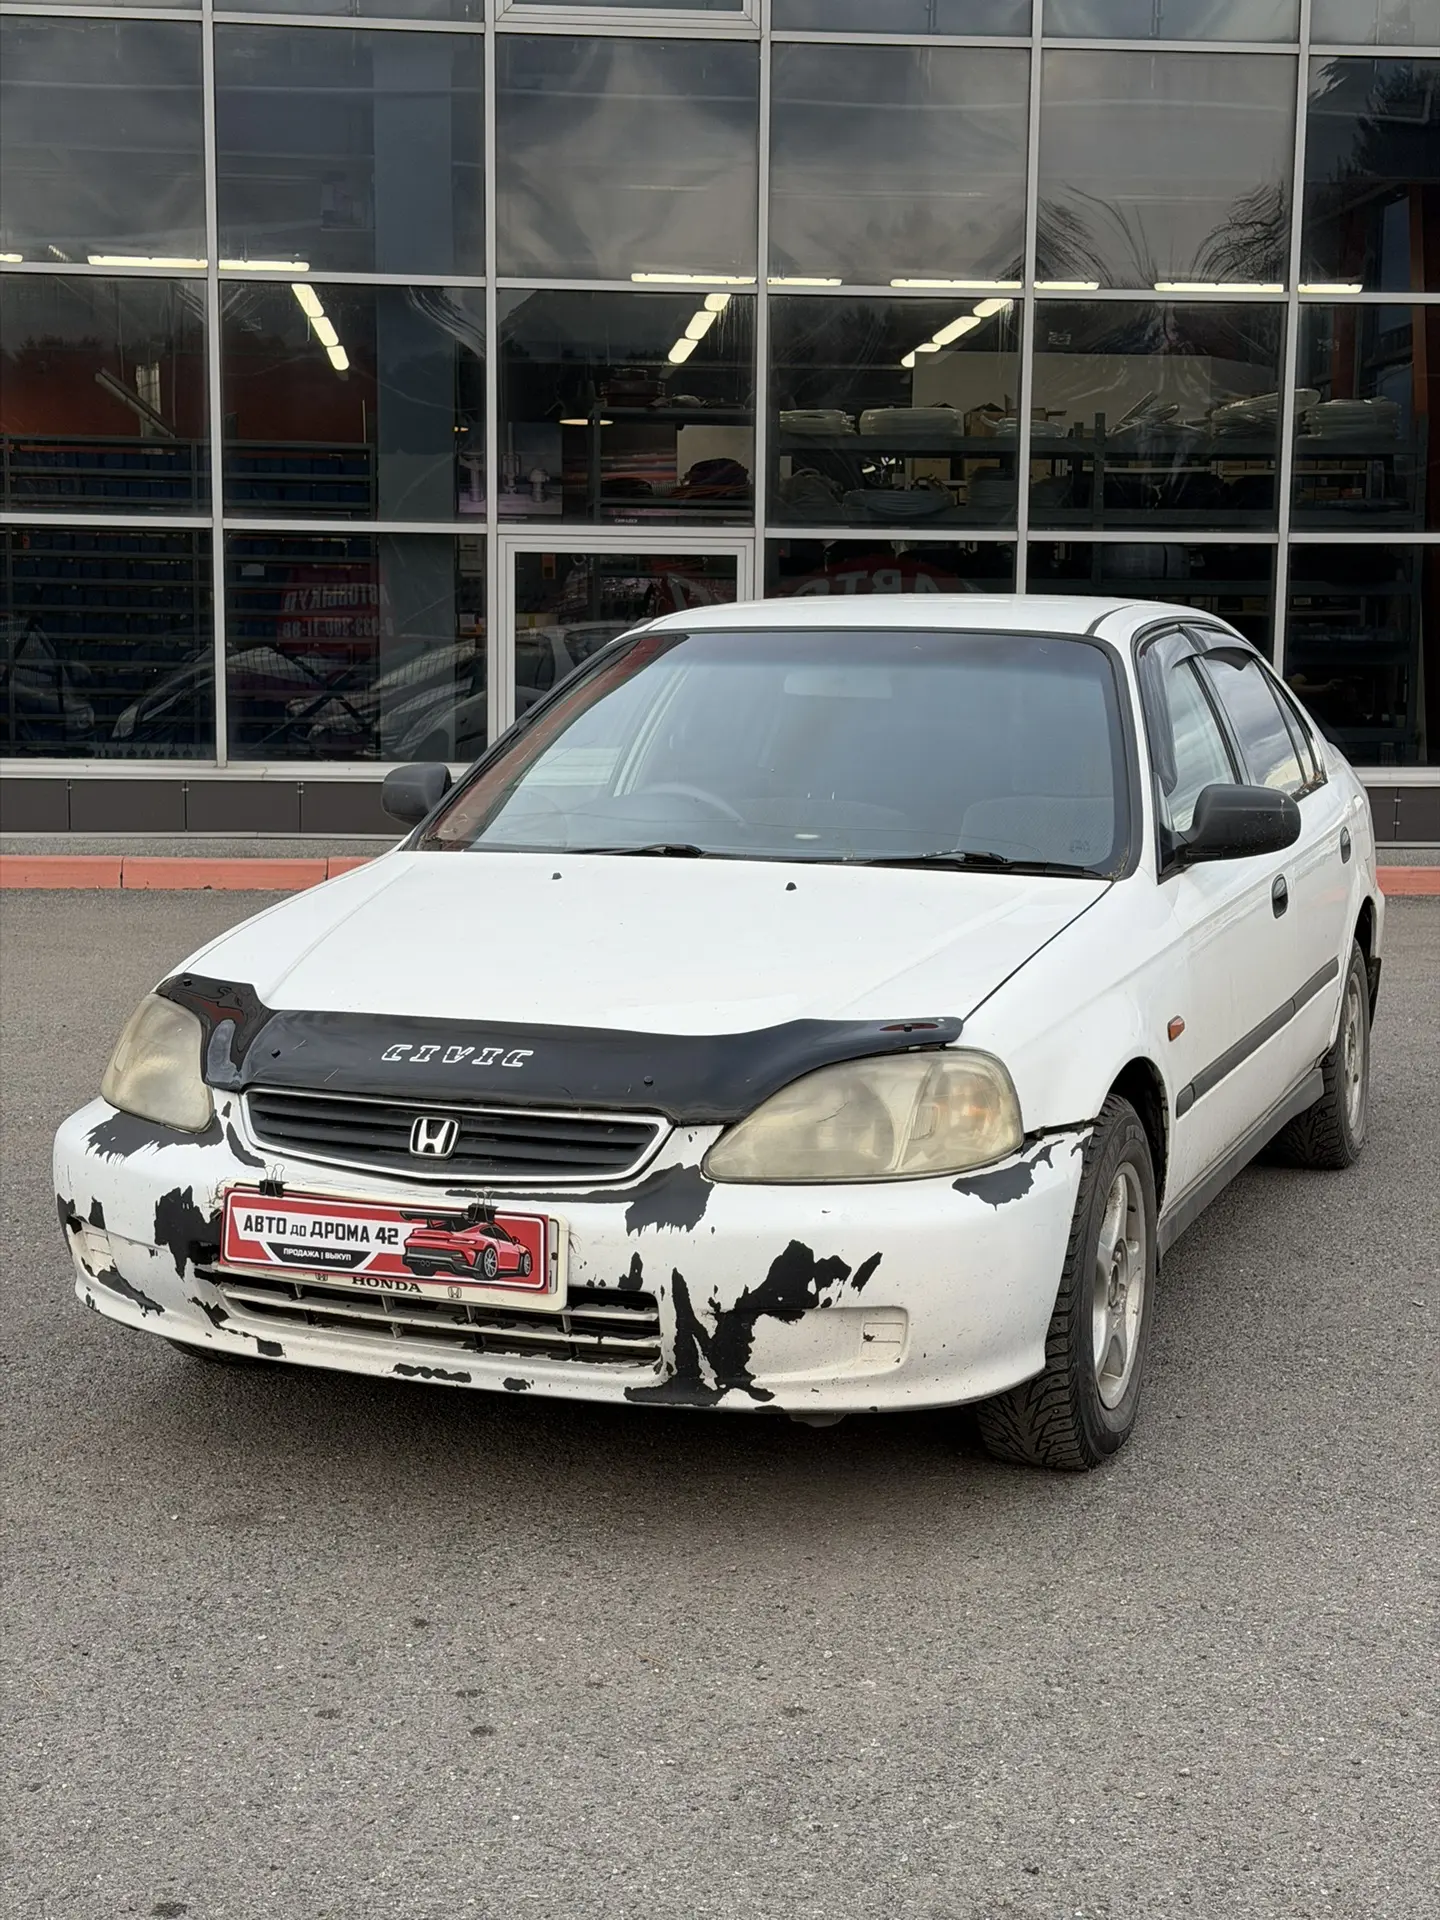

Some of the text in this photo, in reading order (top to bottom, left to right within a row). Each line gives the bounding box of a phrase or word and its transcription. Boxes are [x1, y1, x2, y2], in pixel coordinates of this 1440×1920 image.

[381, 1044, 534, 1067] CIVIC
[243, 1214, 287, 1236] АВТО
[309, 1221, 371, 1243] ДРОМА
[374, 1227, 399, 1246] 42
[283, 1247, 352, 1261] ПРОДАЖА ВЫКУП
[351, 1276, 423, 1294] HONDA
